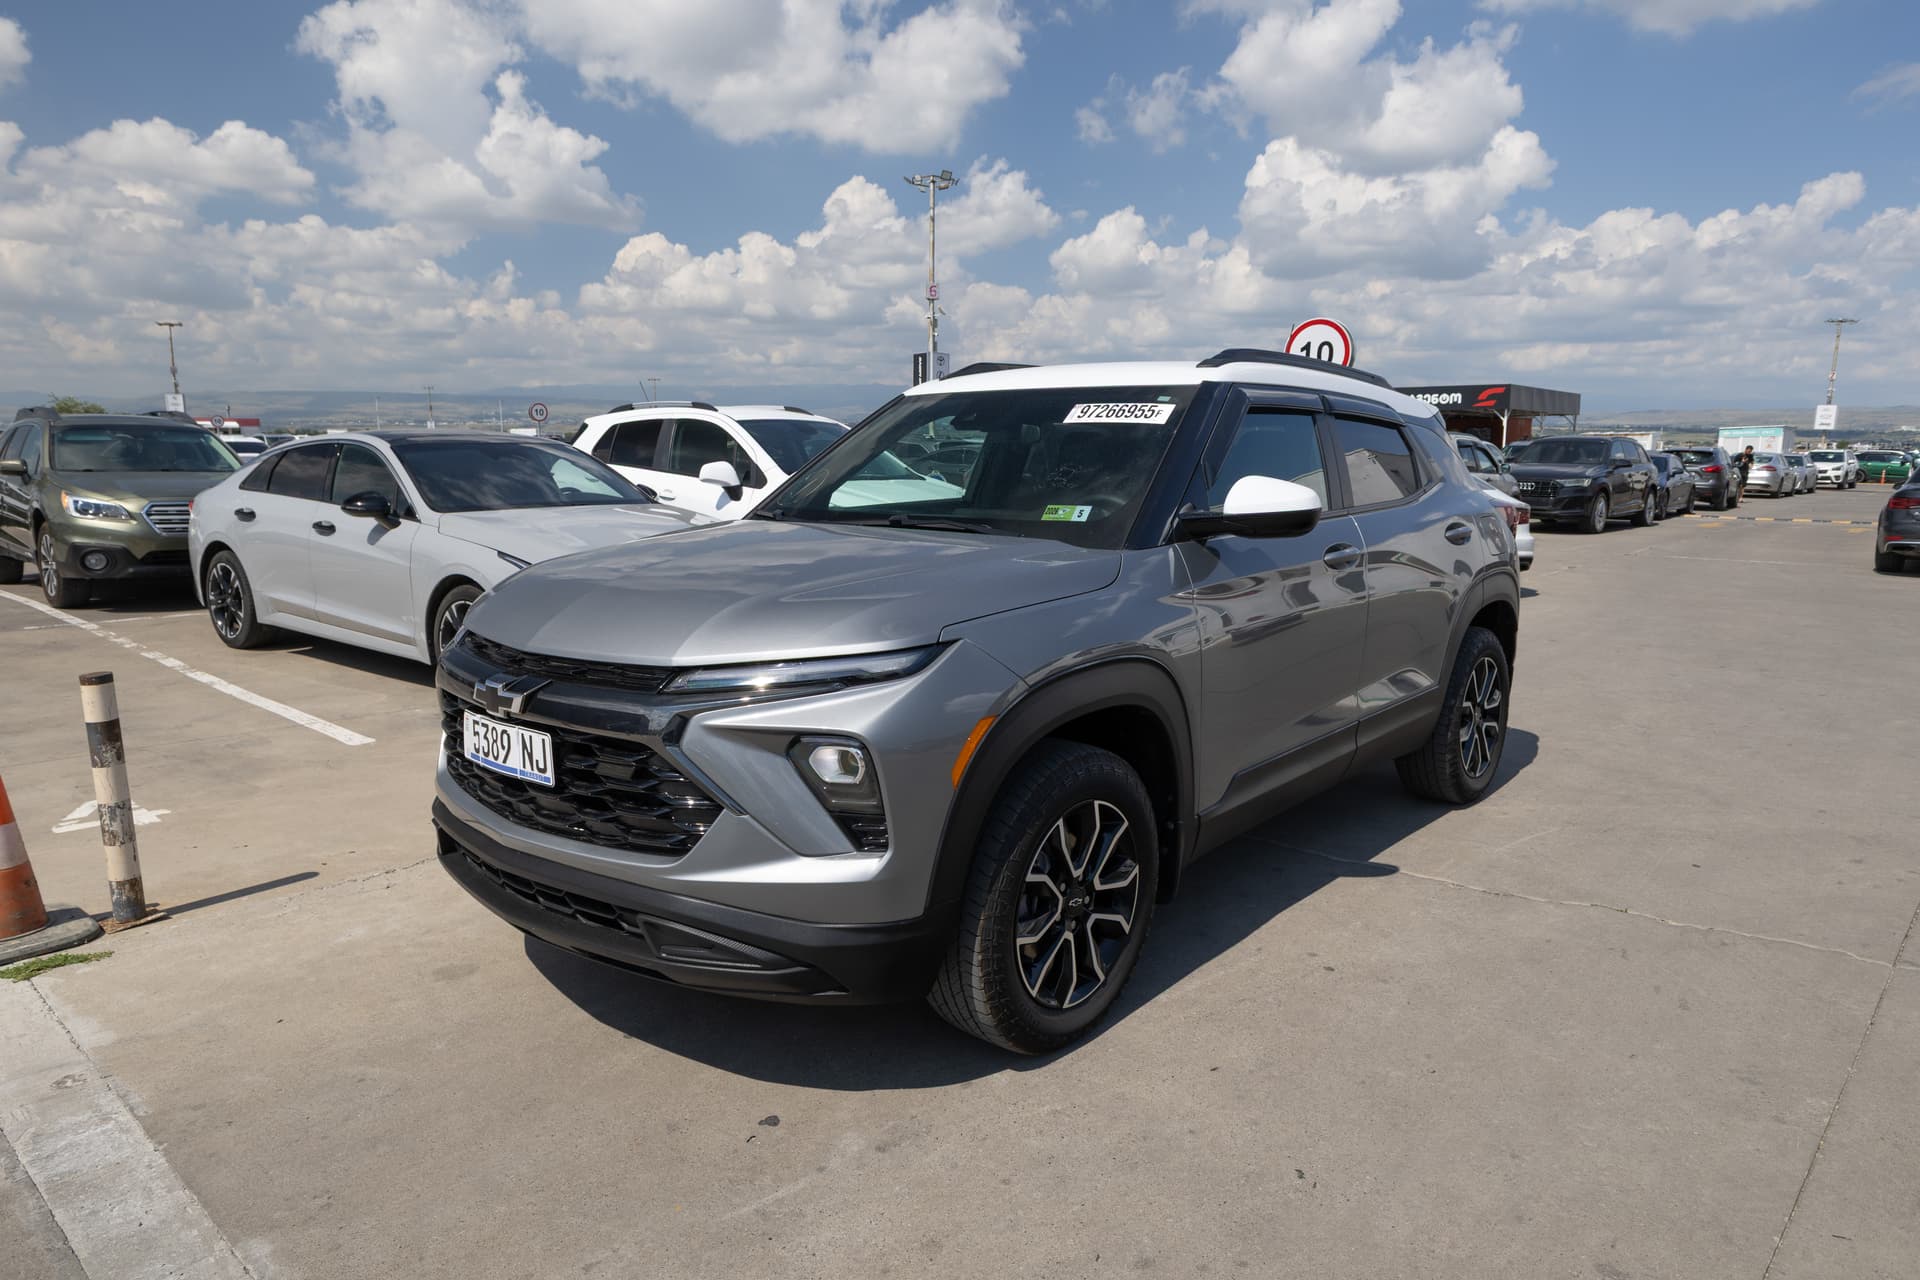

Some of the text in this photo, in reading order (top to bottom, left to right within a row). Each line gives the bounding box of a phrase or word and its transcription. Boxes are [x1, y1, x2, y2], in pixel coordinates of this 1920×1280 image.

[929, 285, 937, 297] 6
[1300, 340, 1334, 362] 10
[535, 408, 545, 417] 10
[1077, 509, 1085, 518] 5
[472, 719, 548, 774] 5389 NJ
